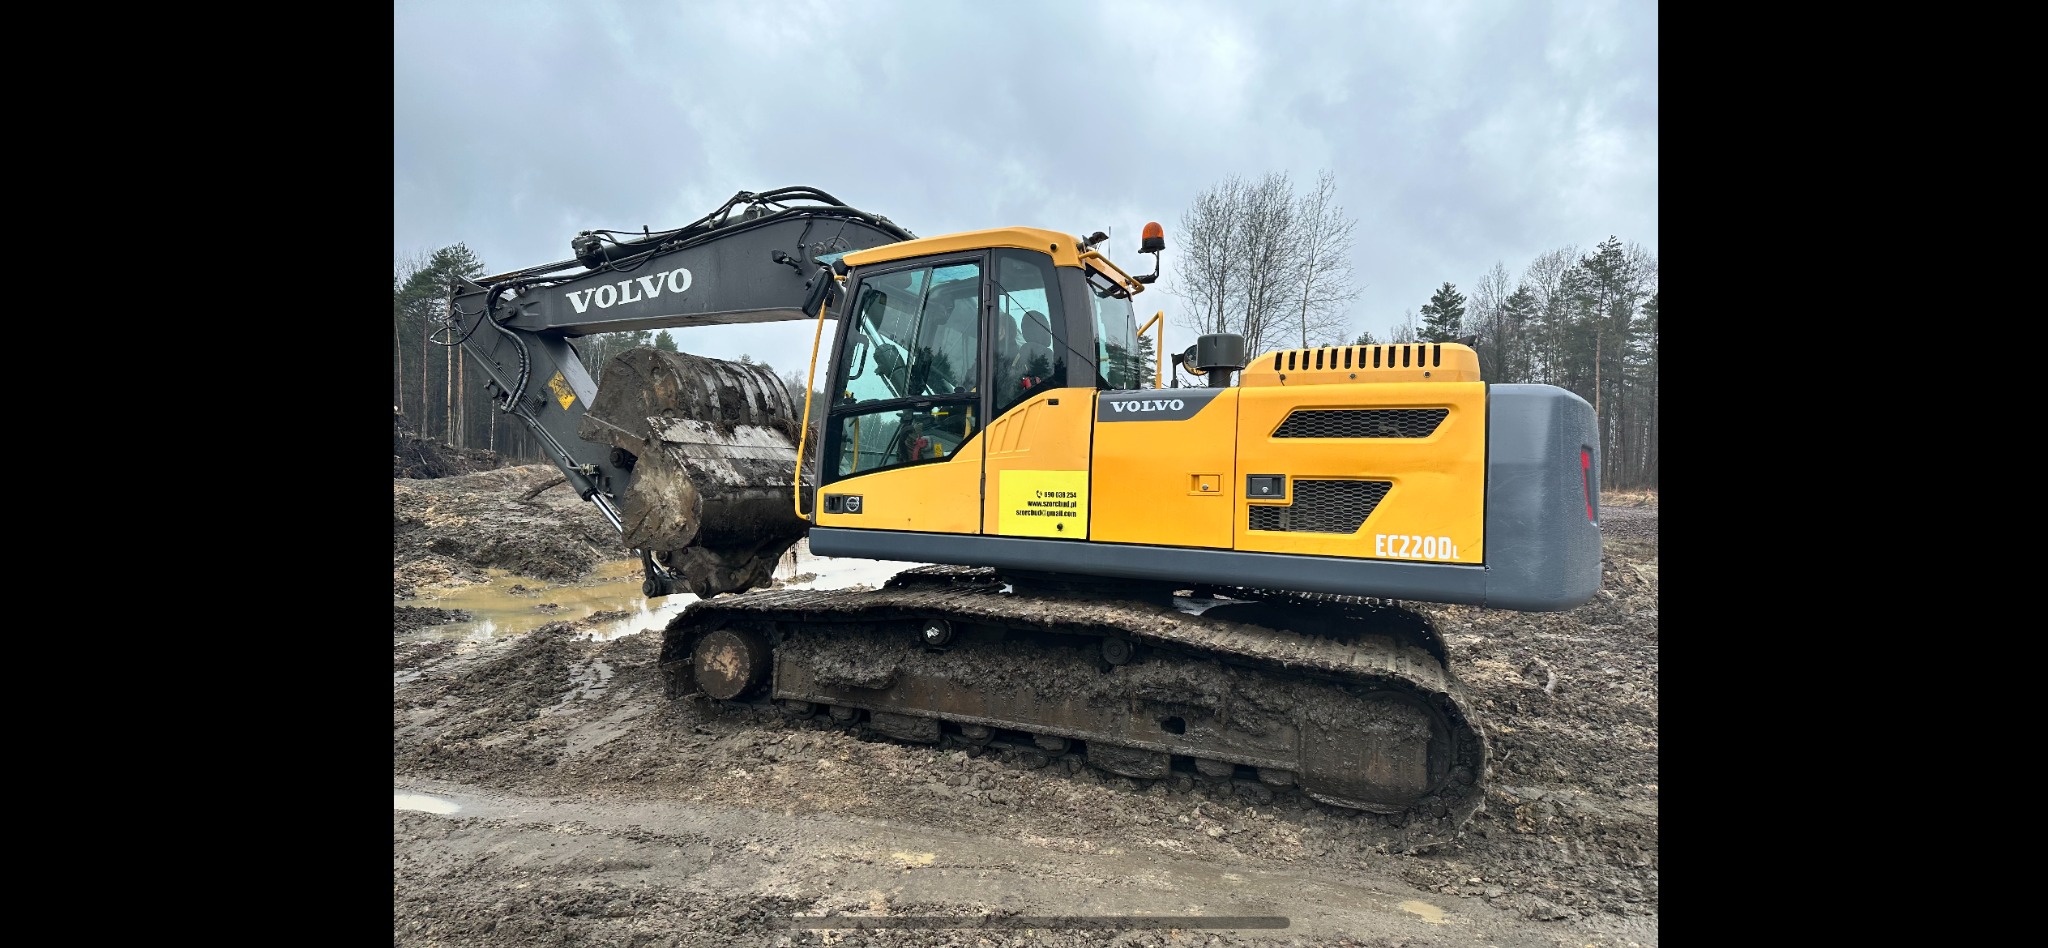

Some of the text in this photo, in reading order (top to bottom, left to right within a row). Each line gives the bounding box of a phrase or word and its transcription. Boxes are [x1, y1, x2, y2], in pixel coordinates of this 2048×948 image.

[565, 267, 692, 313] VOLVO
[1110, 399, 1185, 412] VOLVO
[1066, 491, 1077, 499] 254
[1027, 500, 1077, 508] www.szorcbud.pl
[1016, 509, 1077, 517] szorcbud@gmail.com
